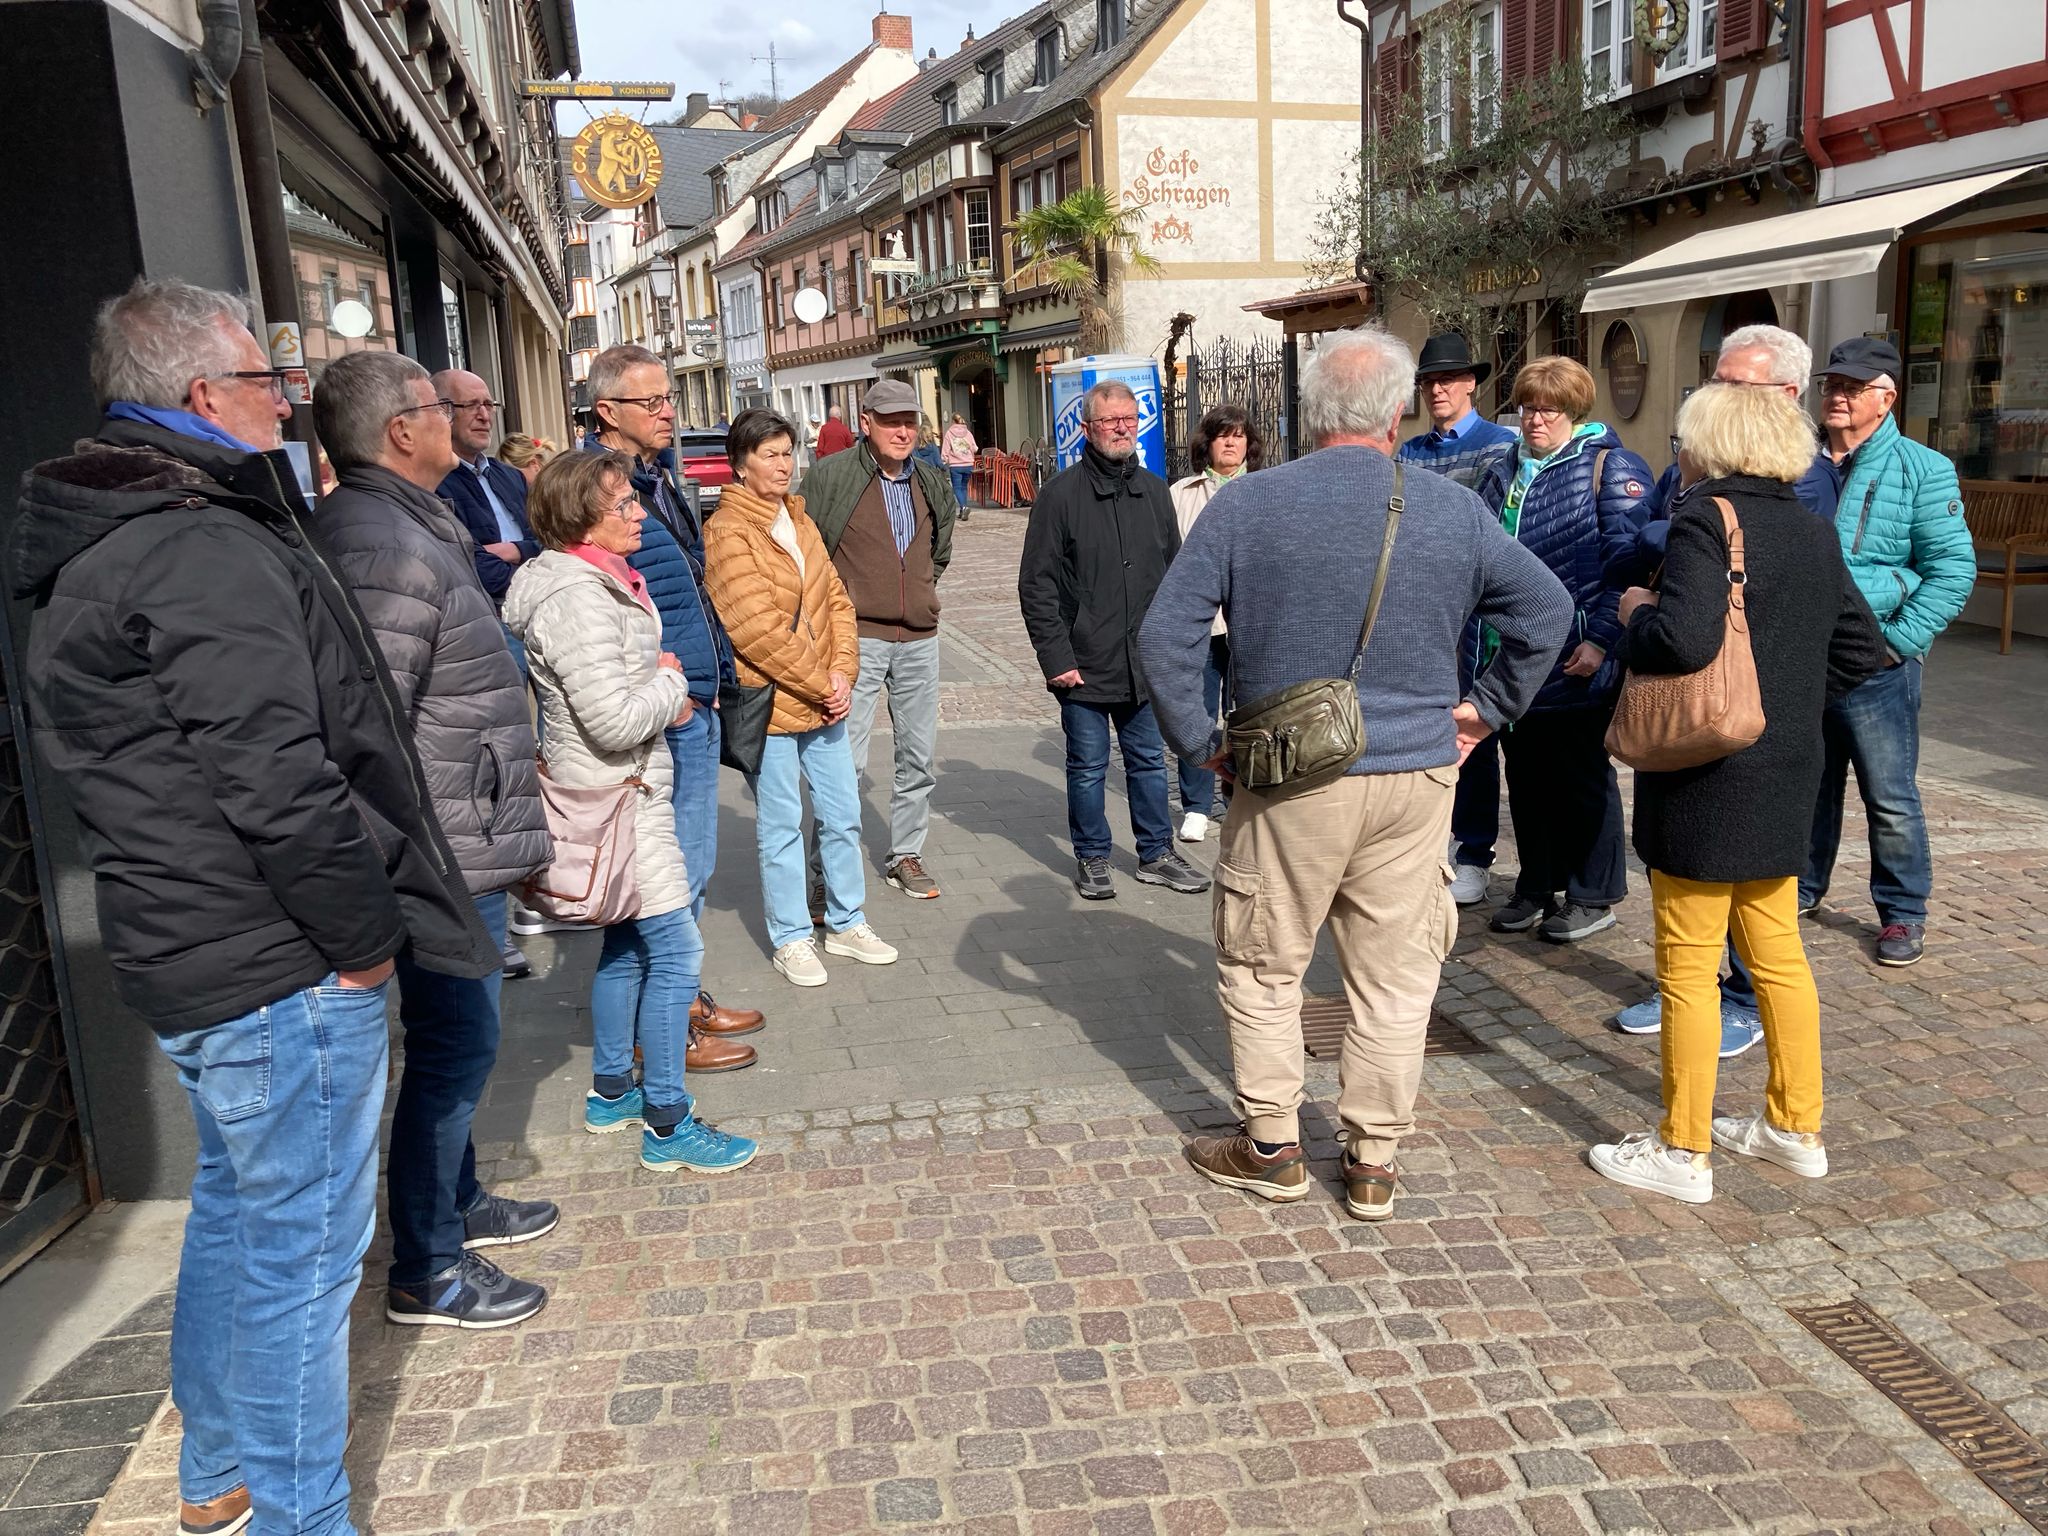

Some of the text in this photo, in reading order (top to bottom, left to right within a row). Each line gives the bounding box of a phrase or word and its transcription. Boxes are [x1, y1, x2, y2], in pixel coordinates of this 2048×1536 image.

[619, 87, 669, 95] KONDITOREI
[630, 125, 662, 188] BERLIN
[1122, 174, 1230, 209] Schragen
